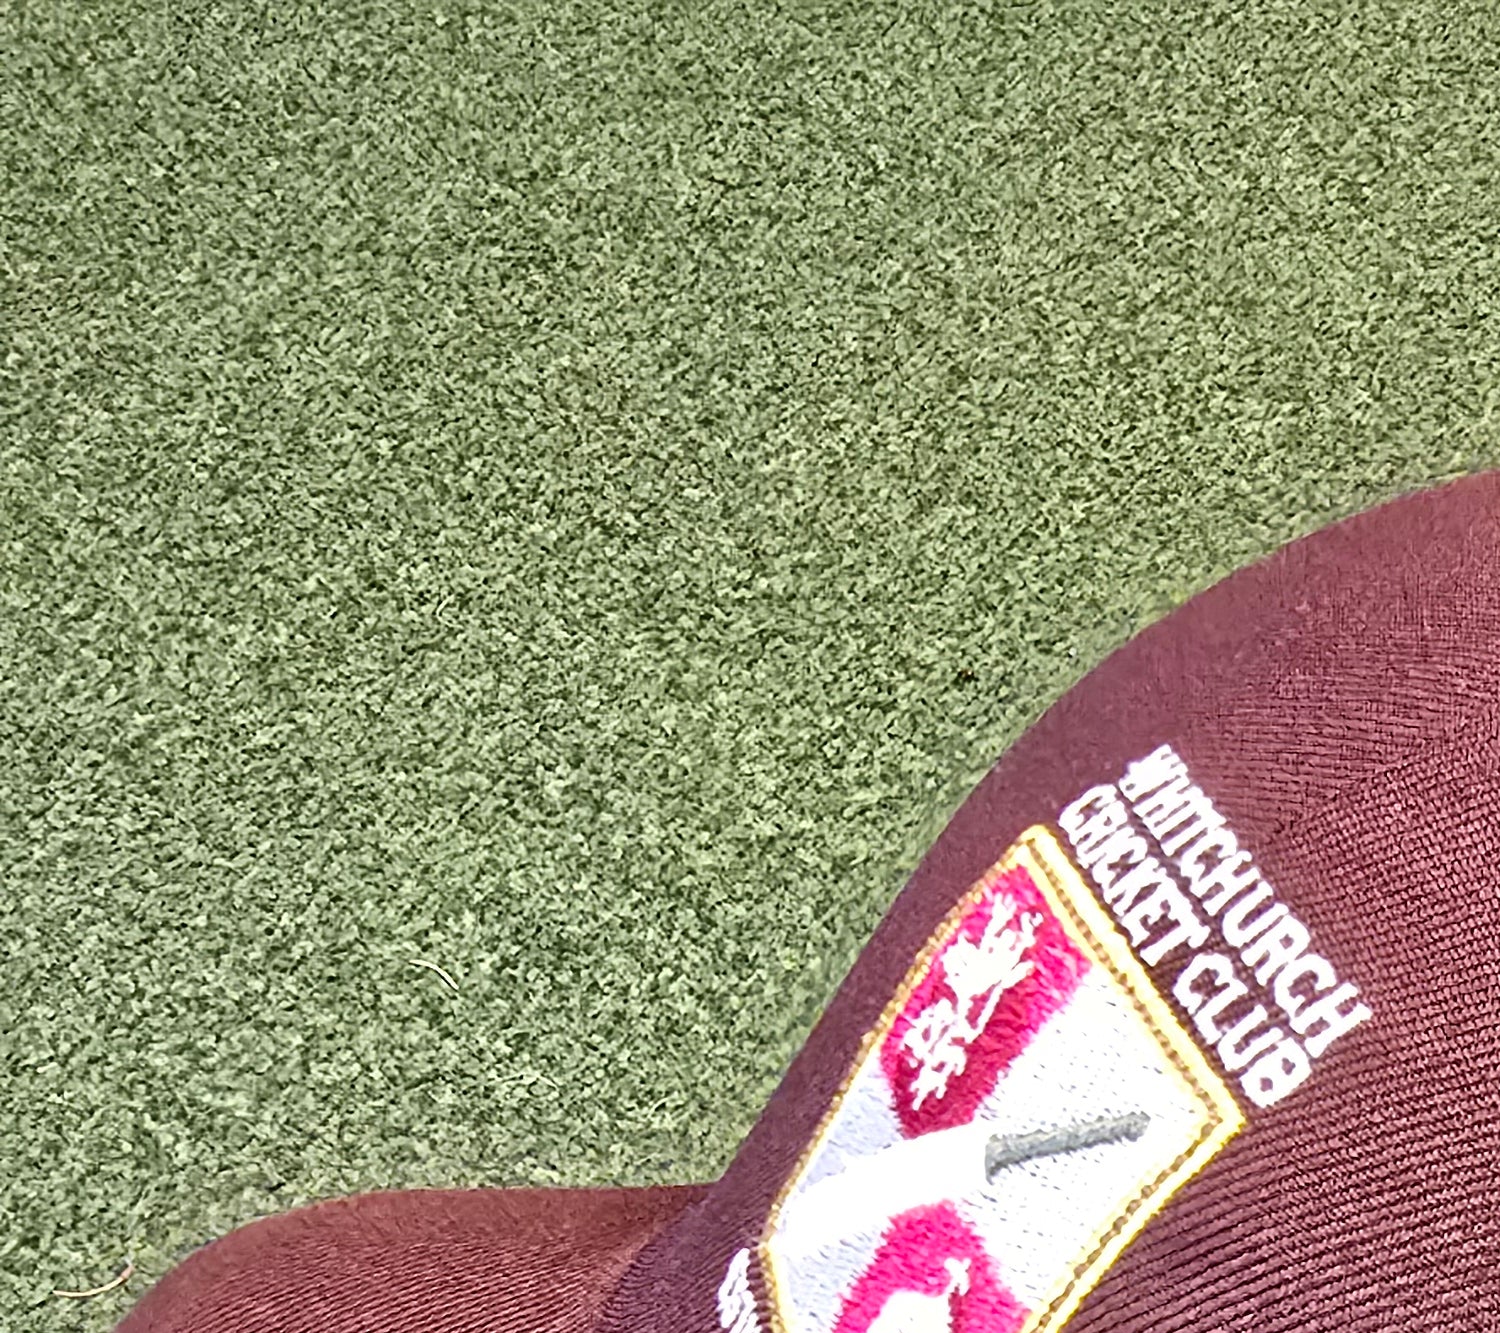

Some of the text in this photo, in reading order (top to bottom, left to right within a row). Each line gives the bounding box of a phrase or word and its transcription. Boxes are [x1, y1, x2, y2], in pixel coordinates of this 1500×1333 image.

[1058, 784, 1312, 1108] CRICKET CLUB
[1118, 743, 1373, 1059] WHITCHURCH
